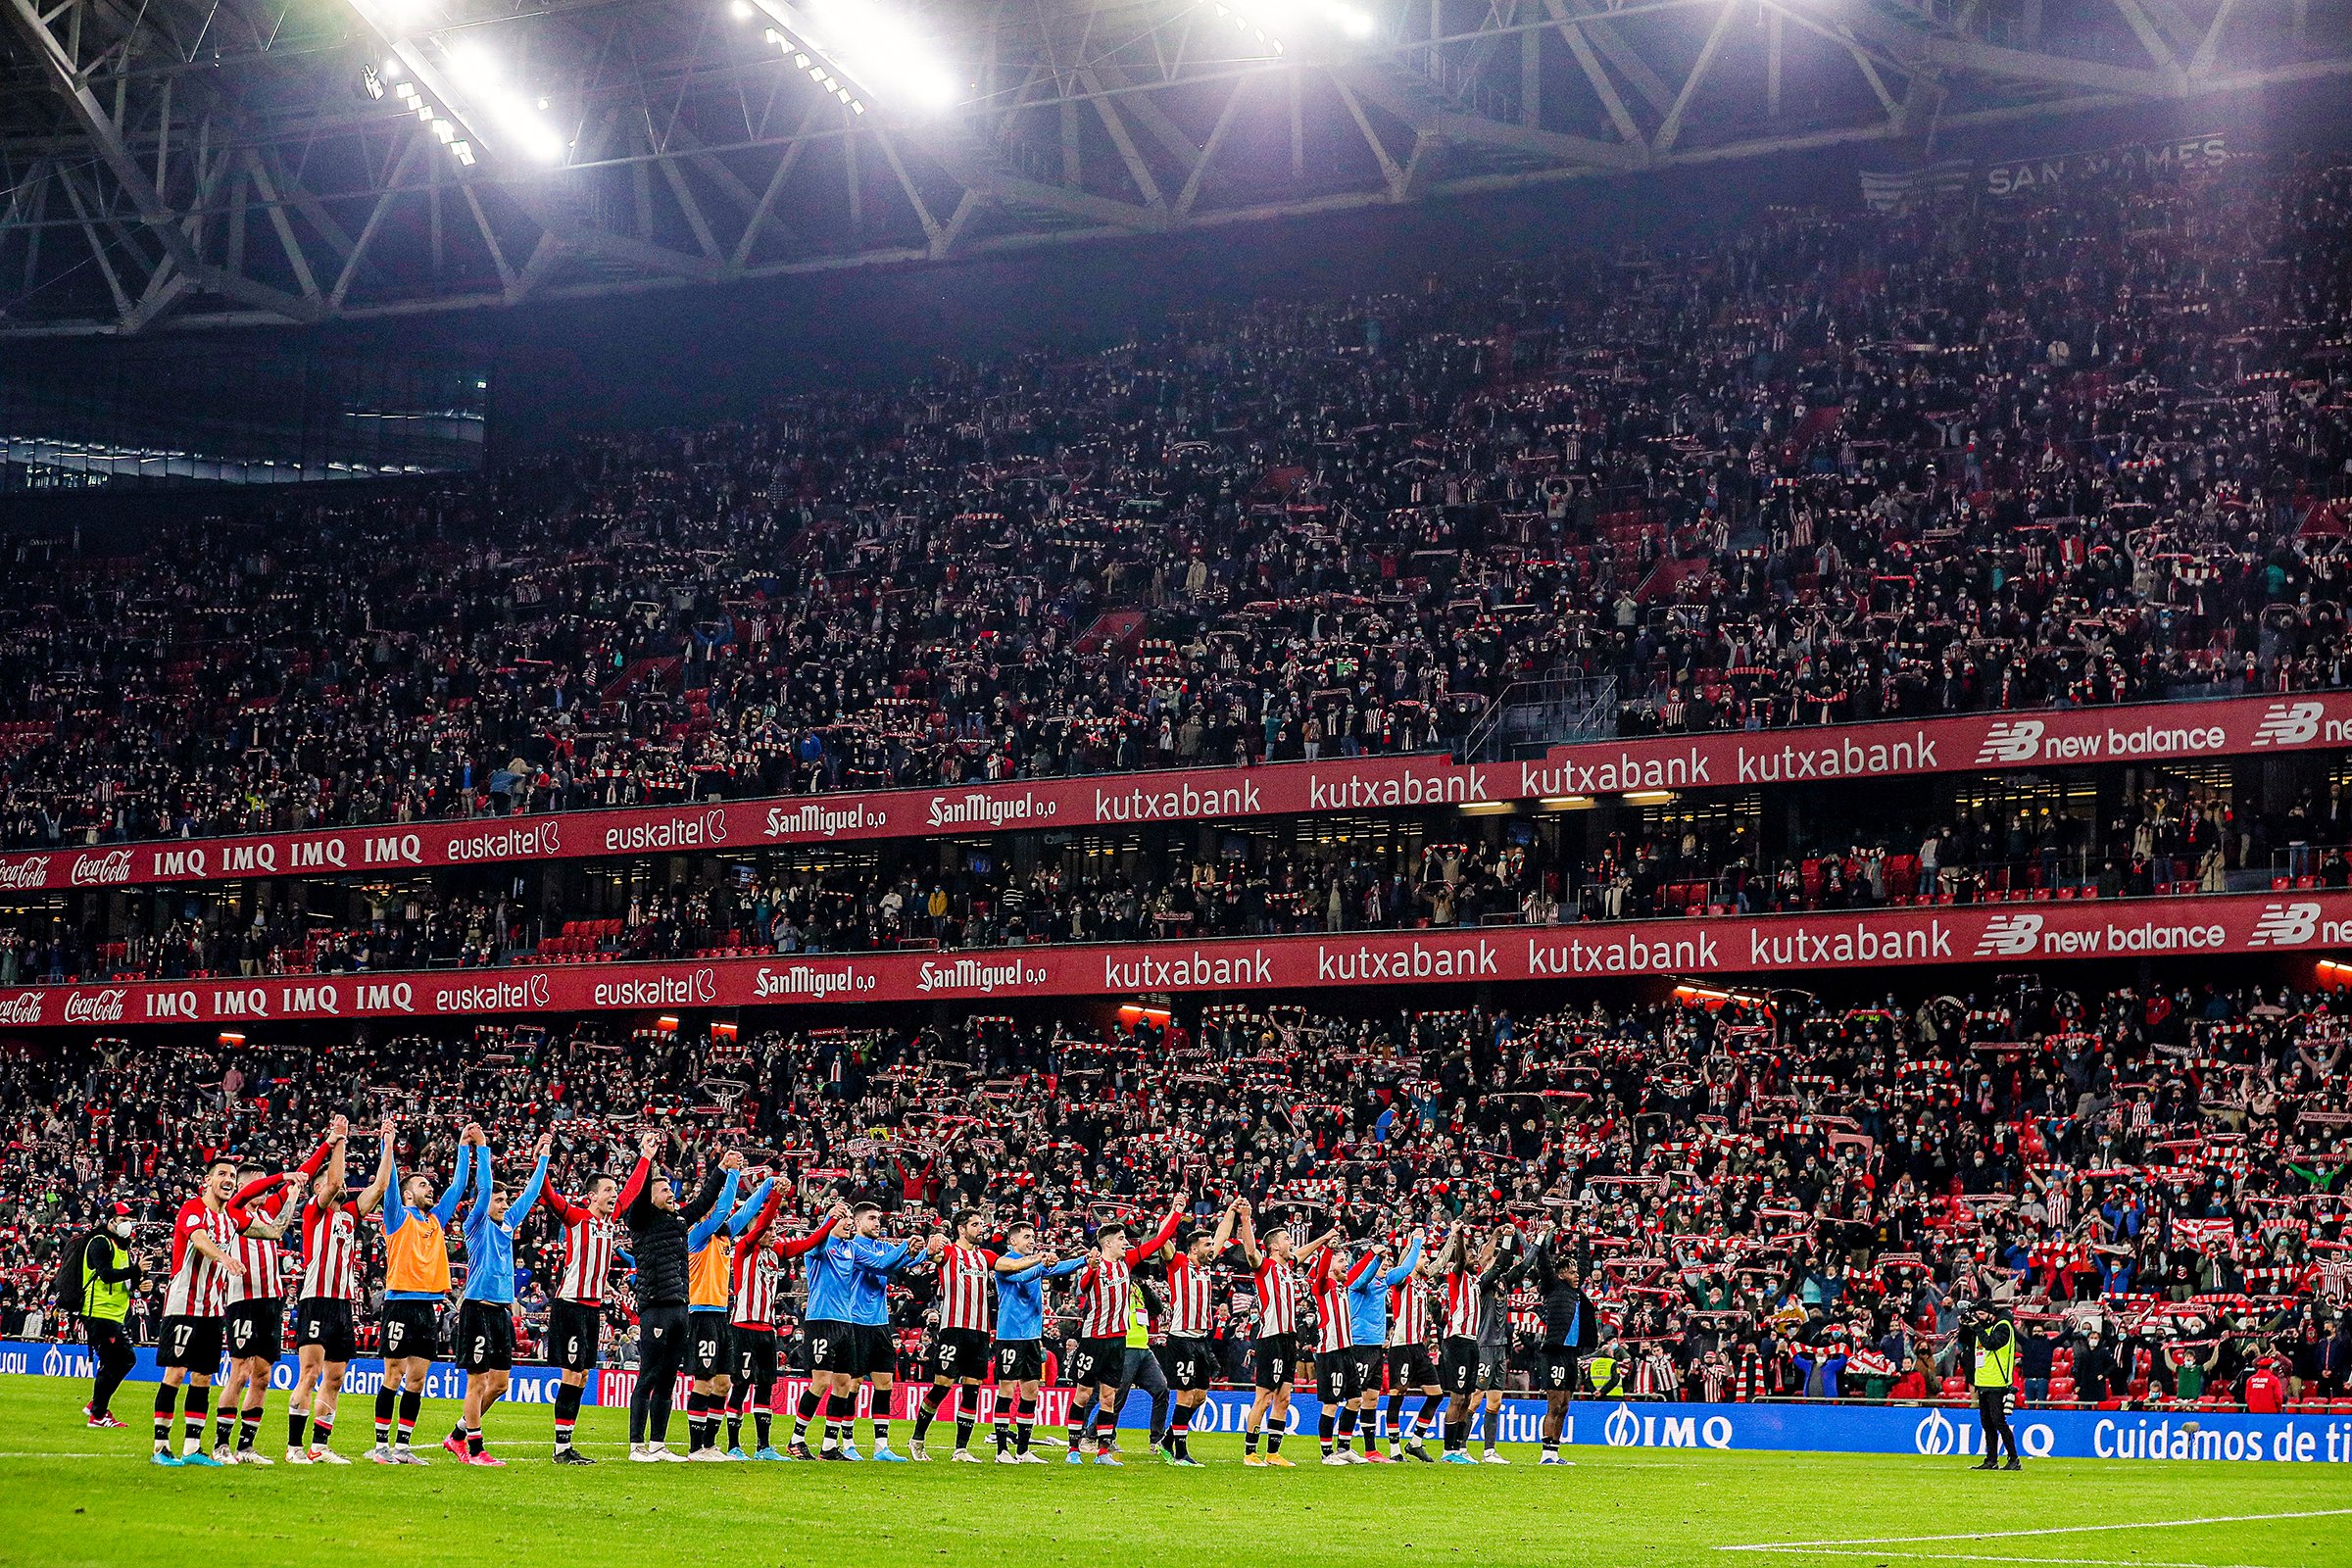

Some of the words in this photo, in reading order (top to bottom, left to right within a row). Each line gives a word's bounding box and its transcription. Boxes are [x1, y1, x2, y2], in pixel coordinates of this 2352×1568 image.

[2046, 734, 2102, 759] new
[2108, 725, 2226, 755] balance
[2326, 719, 2352, 742] ne
[1738, 730, 1937, 783] kutxabank
[1523, 752, 1710, 797] kutxabank
[1311, 766, 1488, 809] kutxabank
[1036, 801, 1056, 819] 0,0
[1096, 778, 1261, 822] kutxabank
[866, 811, 886, 829] 0,0
[448, 827, 539, 860] euskaltel
[606, 815, 704, 850] euskaltel
[222, 843, 277, 872] IMQ
[291, 838, 348, 868] IMQ
[365, 834, 423, 864] IMQ
[154, 849, 207, 877] IMQ
[1752, 919, 1952, 964] kutxabank
[2044, 930, 2101, 953] new
[2108, 922, 2226, 952] balance
[2322, 919, 2352, 943] ne
[1318, 939, 1497, 980] kutxabank
[1530, 931, 1719, 978] kutxabank
[1025, 968, 1047, 986] 0,0
[1105, 948, 1272, 989] kutxabank
[436, 980, 528, 1011] euskaltel
[594, 974, 693, 1005] euskaltel
[856, 975, 876, 993] 0,0
[146, 990, 199, 1019] IMQ
[214, 988, 270, 1017] IMQ
[282, 985, 340, 1015] IMQ
[356, 982, 415, 1012] IMQ
[174, 1324, 192, 1346] 17
[233, 1319, 253, 1340] 14
[309, 1321, 320, 1339] 5
[388, 1321, 405, 1341] 15
[474, 1336, 485, 1353] 2
[567, 1336, 578, 1353] 6
[698, 1340, 716, 1357] 20
[811, 1339, 828, 1354] 12
[939, 1345, 956, 1361] 22
[1001, 1348, 1016, 1364] 19
[65, 1354, 101, 1378] IM
[742, 1351, 752, 1369] 7
[1077, 1352, 1093, 1370] 33
[1176, 1360, 1195, 1377] 24
[1272, 1357, 1283, 1374] 18
[1399, 1363, 1409, 1377] 4
[1477, 1362, 1491, 1377] 26
[444, 1368, 460, 1399] ti
[1330, 1372, 1344, 1388] 10
[1458, 1365, 1466, 1380] 9
[1550, 1365, 1565, 1380] 30
[1643, 1415, 1733, 1450] IMQ
[2093, 1418, 2263, 1461] Cuidamos
[2273, 1421, 2316, 1462] de
[2326, 1422, 2352, 1463] ti
